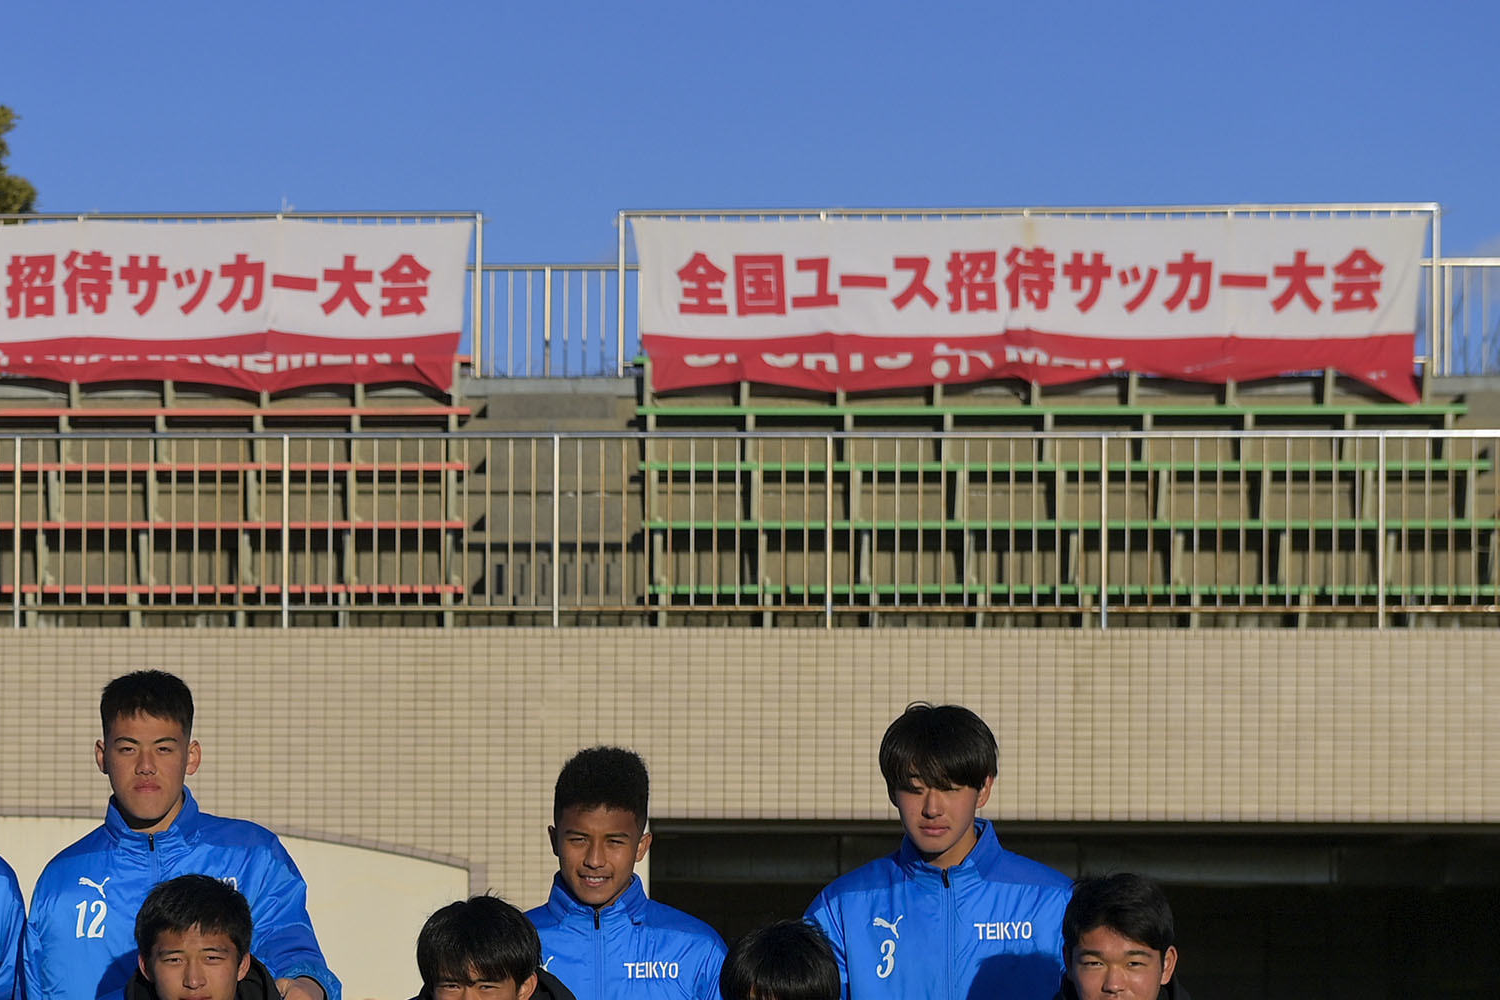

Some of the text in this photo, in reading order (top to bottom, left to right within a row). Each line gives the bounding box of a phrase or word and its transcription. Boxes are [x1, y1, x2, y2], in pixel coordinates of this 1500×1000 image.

[677, 247, 1385, 317] 全国ユース招待サッカー大会
[76, 899, 107, 938] 12
[974, 921, 1032, 940] TEIKYO
[623, 961, 679, 979] TEIKYO
[876, 938, 896, 979] 3
